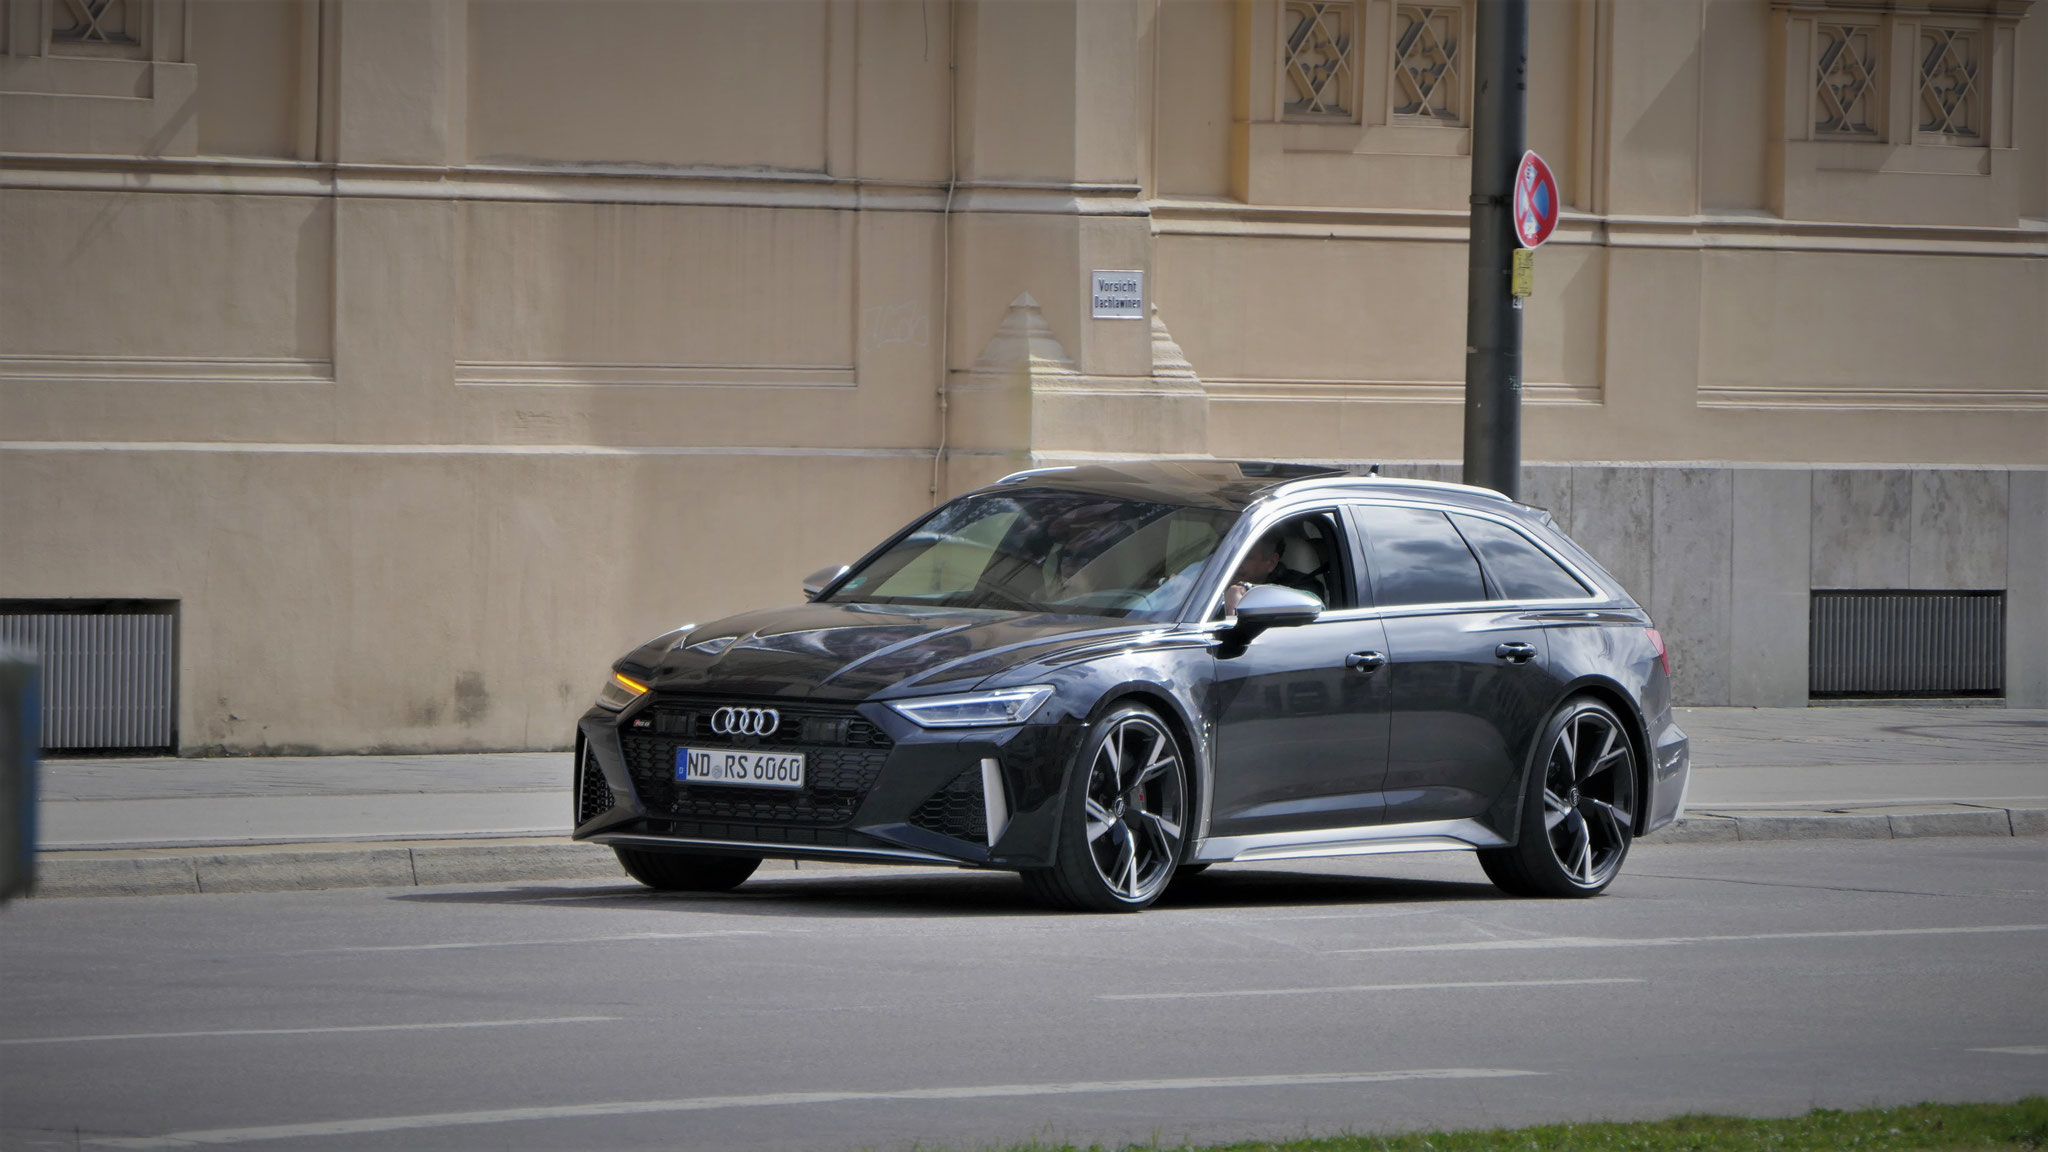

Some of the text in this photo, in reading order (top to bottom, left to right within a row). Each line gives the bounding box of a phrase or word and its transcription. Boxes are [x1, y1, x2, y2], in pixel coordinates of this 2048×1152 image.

[1098, 279, 1137, 292] Vorsicht
[1094, 296, 1141, 309] Dachlawinen
[687, 752, 801, 782] ND RS 6060
